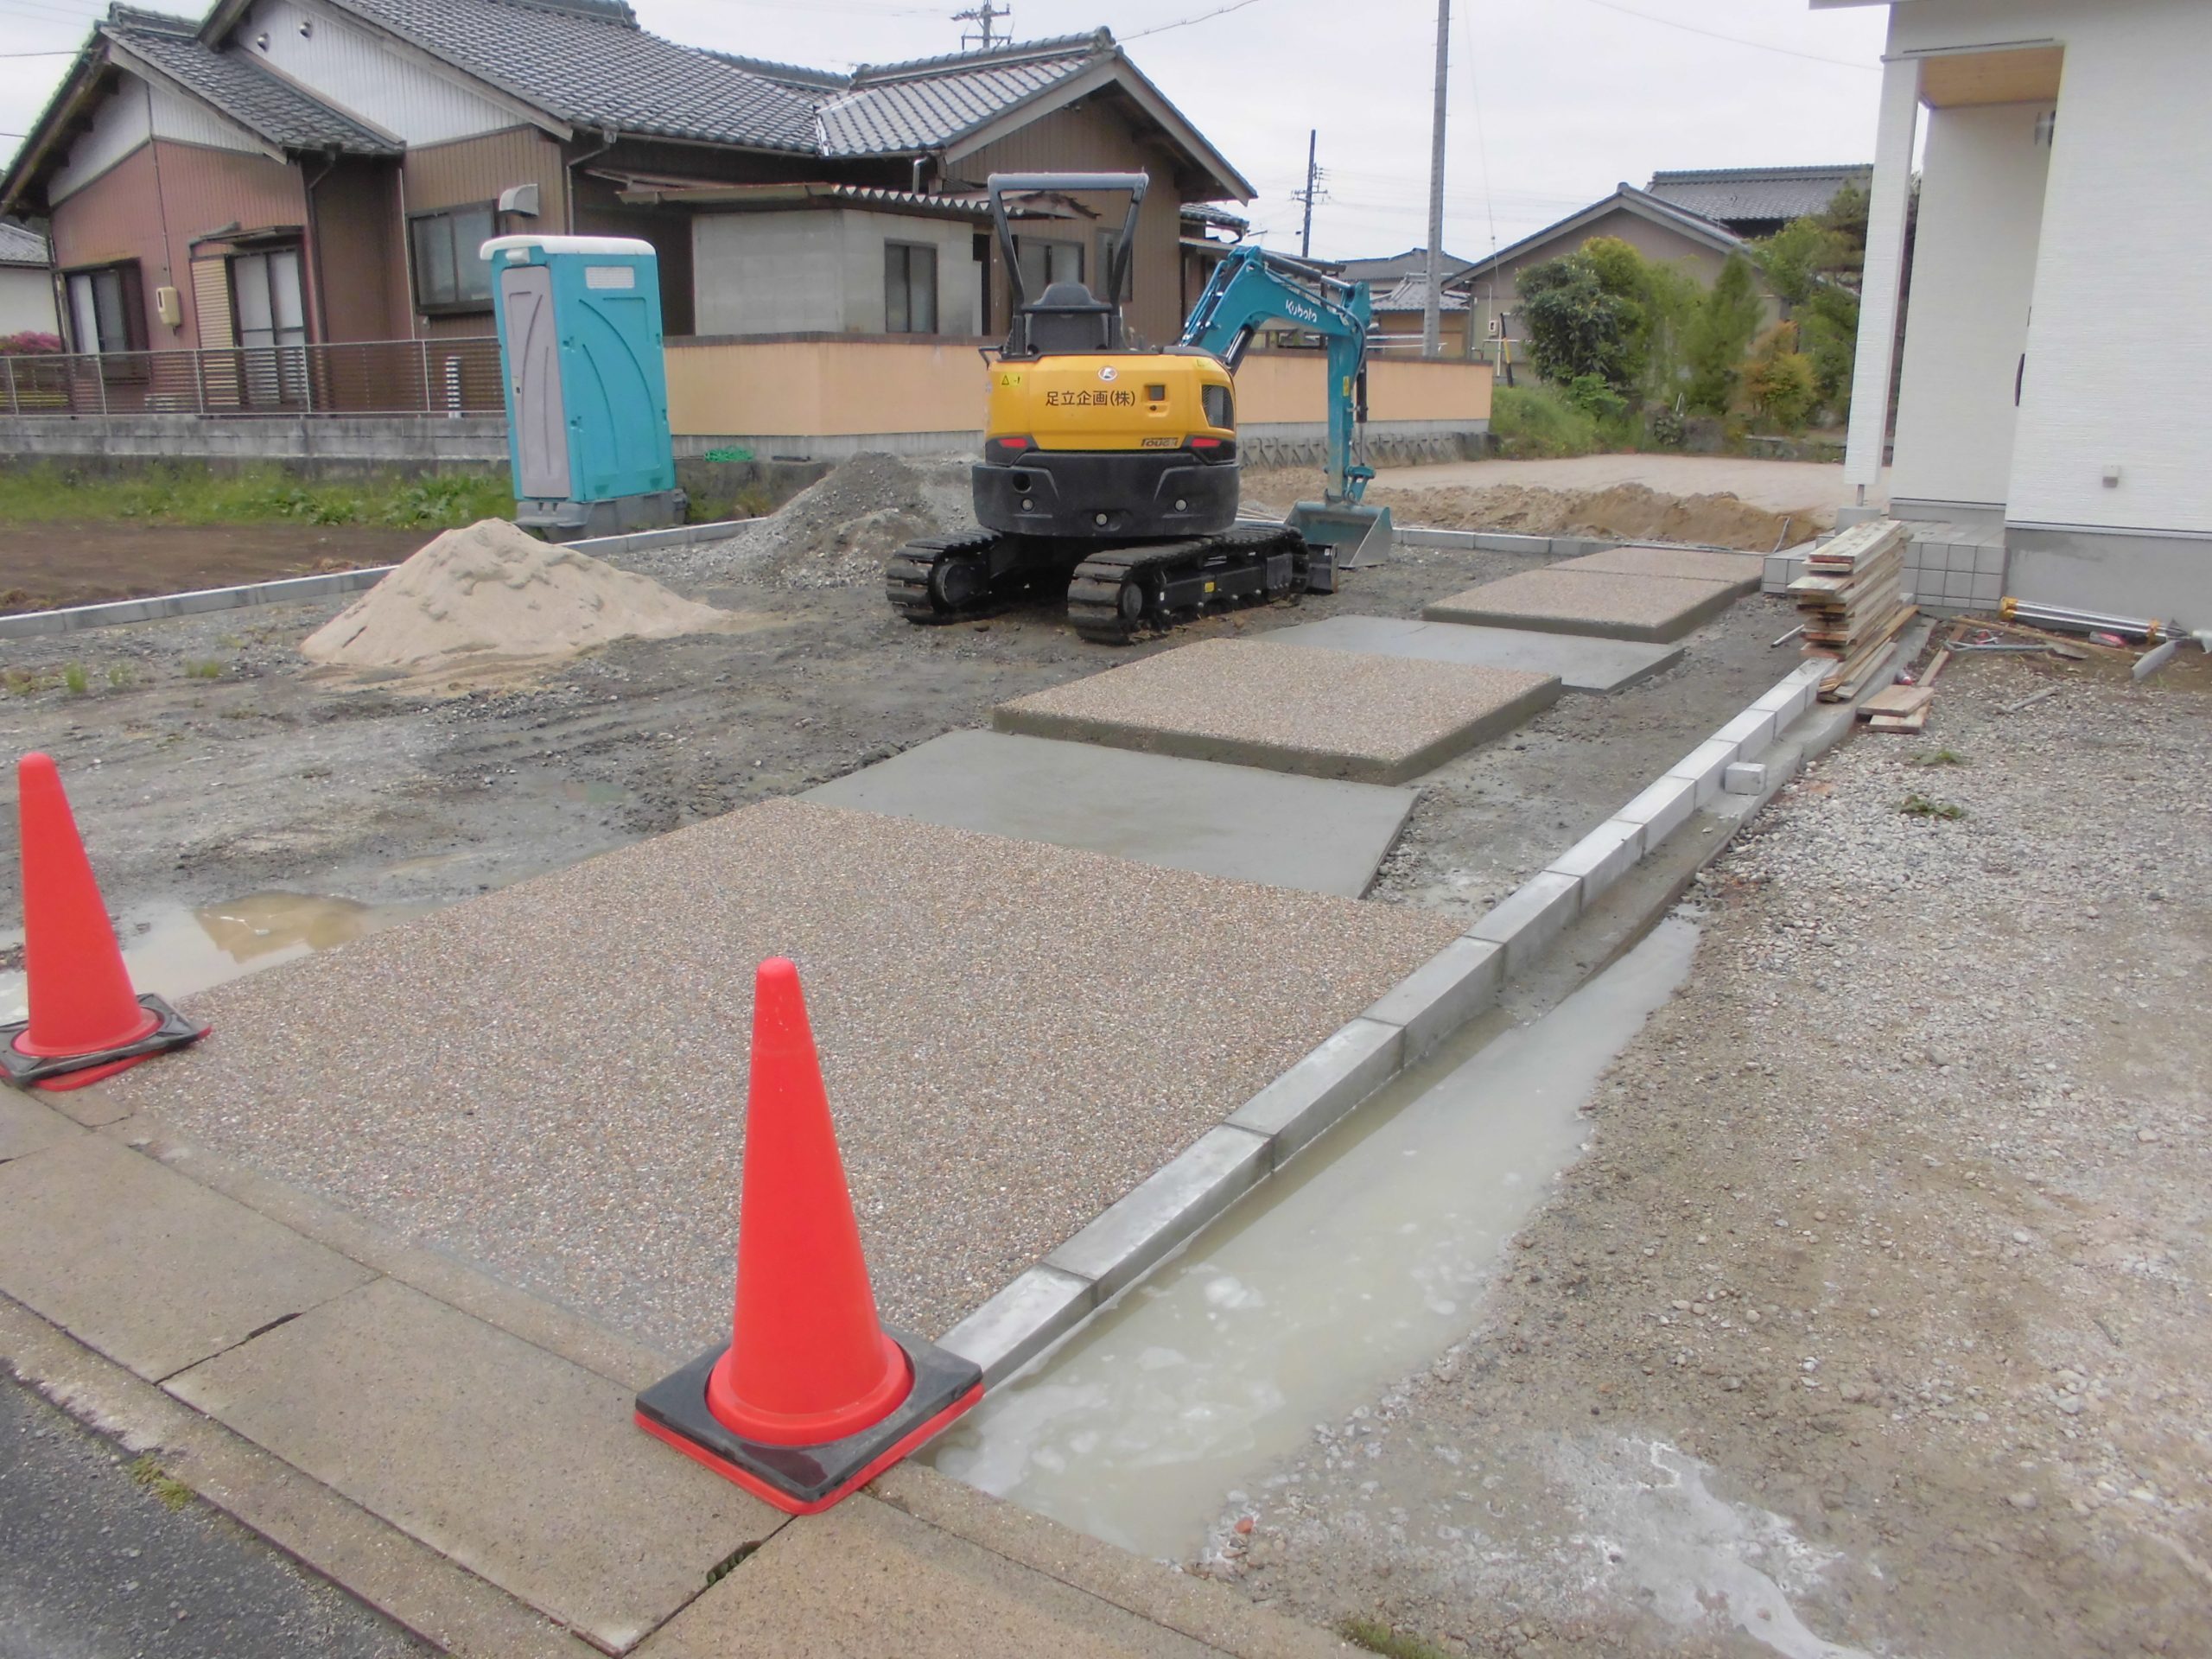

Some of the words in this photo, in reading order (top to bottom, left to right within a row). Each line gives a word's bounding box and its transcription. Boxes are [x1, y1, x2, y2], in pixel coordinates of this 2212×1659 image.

[1046, 391, 1136, 407] 足立企画(株)
